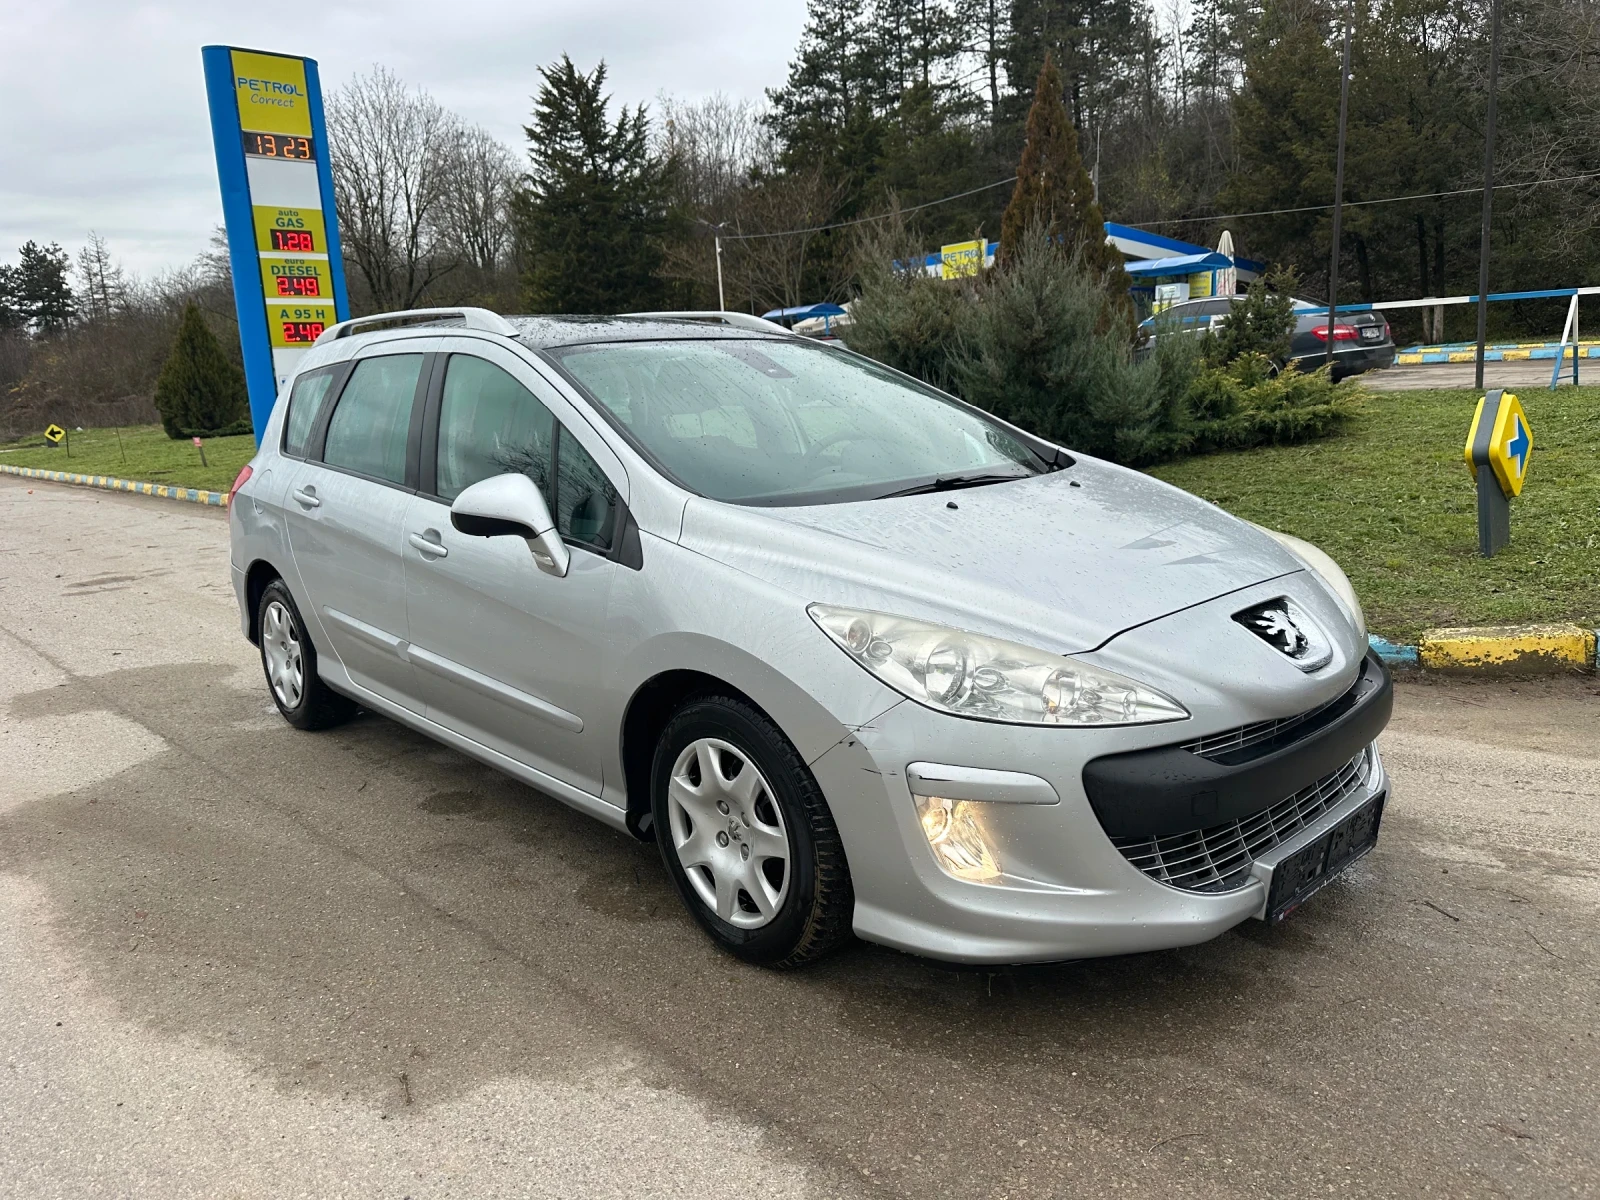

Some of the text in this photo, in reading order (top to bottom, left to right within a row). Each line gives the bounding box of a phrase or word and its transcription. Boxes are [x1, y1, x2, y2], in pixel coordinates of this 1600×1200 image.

[237, 77, 304, 97] PETROL
[250, 93, 295, 108] Correct
[278, 209, 299, 217] auto
[275, 217, 305, 229] GAS
[276, 231, 312, 252] 1.28
[270, 265, 322, 276] DIESEL
[277, 277, 319, 296] 2.49
[280, 309, 326, 319] A 95 H
